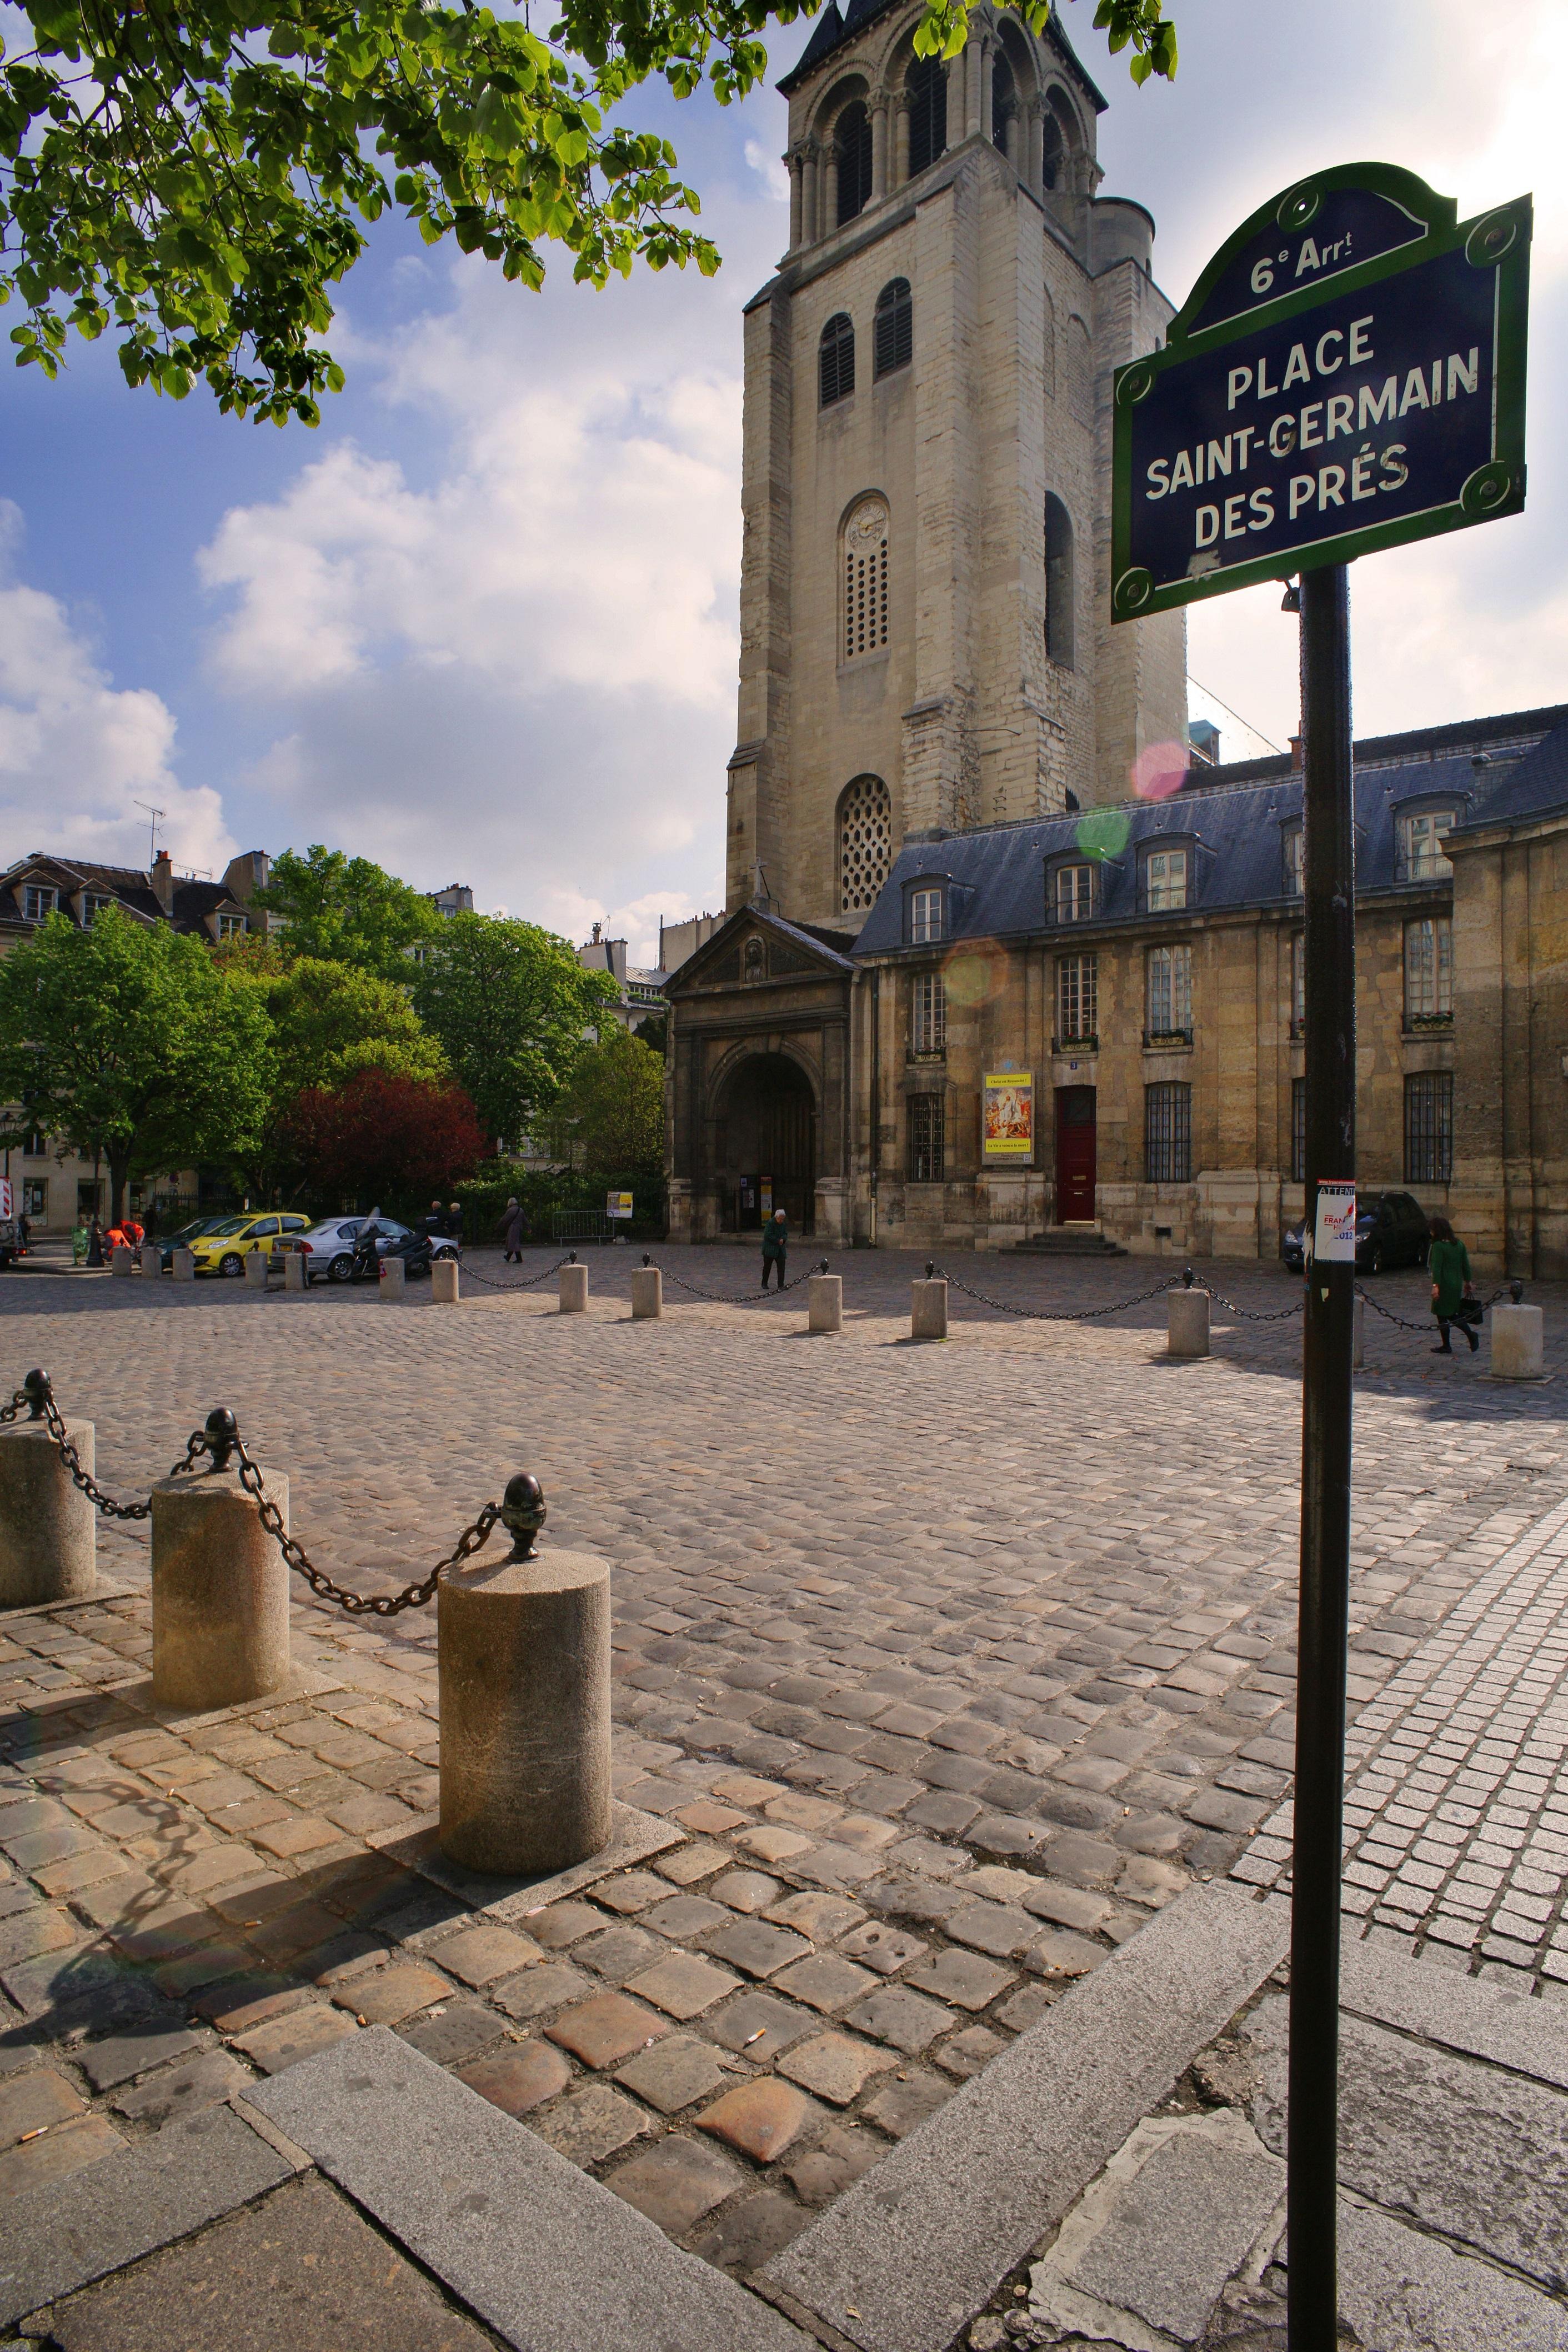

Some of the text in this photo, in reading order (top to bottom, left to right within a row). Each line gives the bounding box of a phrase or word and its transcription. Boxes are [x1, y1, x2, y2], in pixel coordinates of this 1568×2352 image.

[1228, 314, 1374, 411] PLACE
[1145, 346, 1479, 501] SAINT-GERMAIN
[1195, 443, 1409, 549] DES PRÉS
